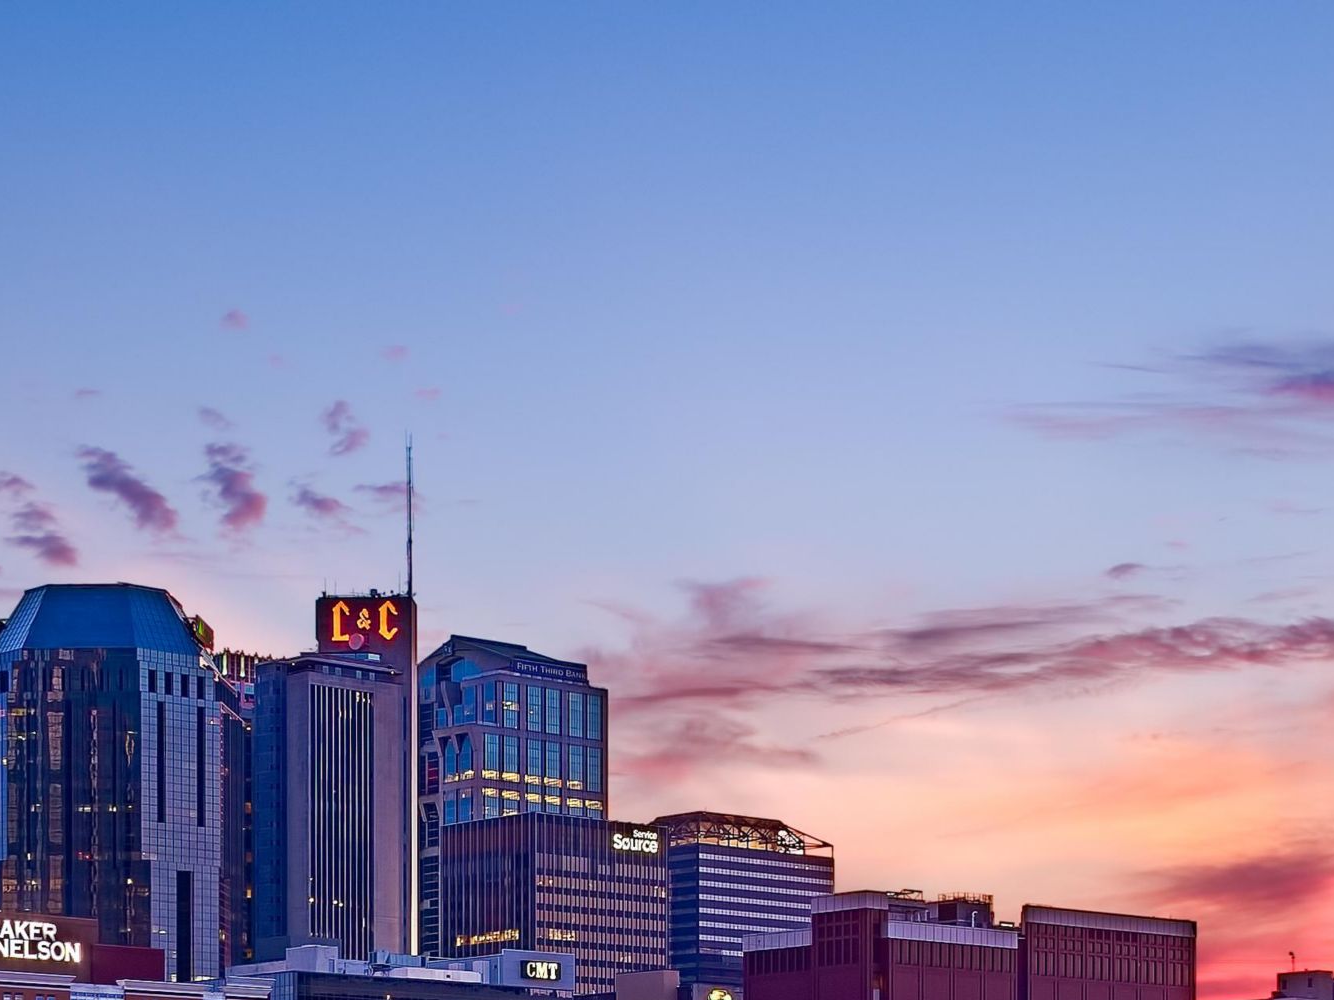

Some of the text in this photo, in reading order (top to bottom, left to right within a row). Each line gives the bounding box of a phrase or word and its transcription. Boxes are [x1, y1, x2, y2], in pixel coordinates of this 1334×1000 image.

[331, 600, 398, 641] L & C
[613, 833, 659, 853] Source
[633, 829, 658, 840] Service
[526, 962, 558, 980] CMT
